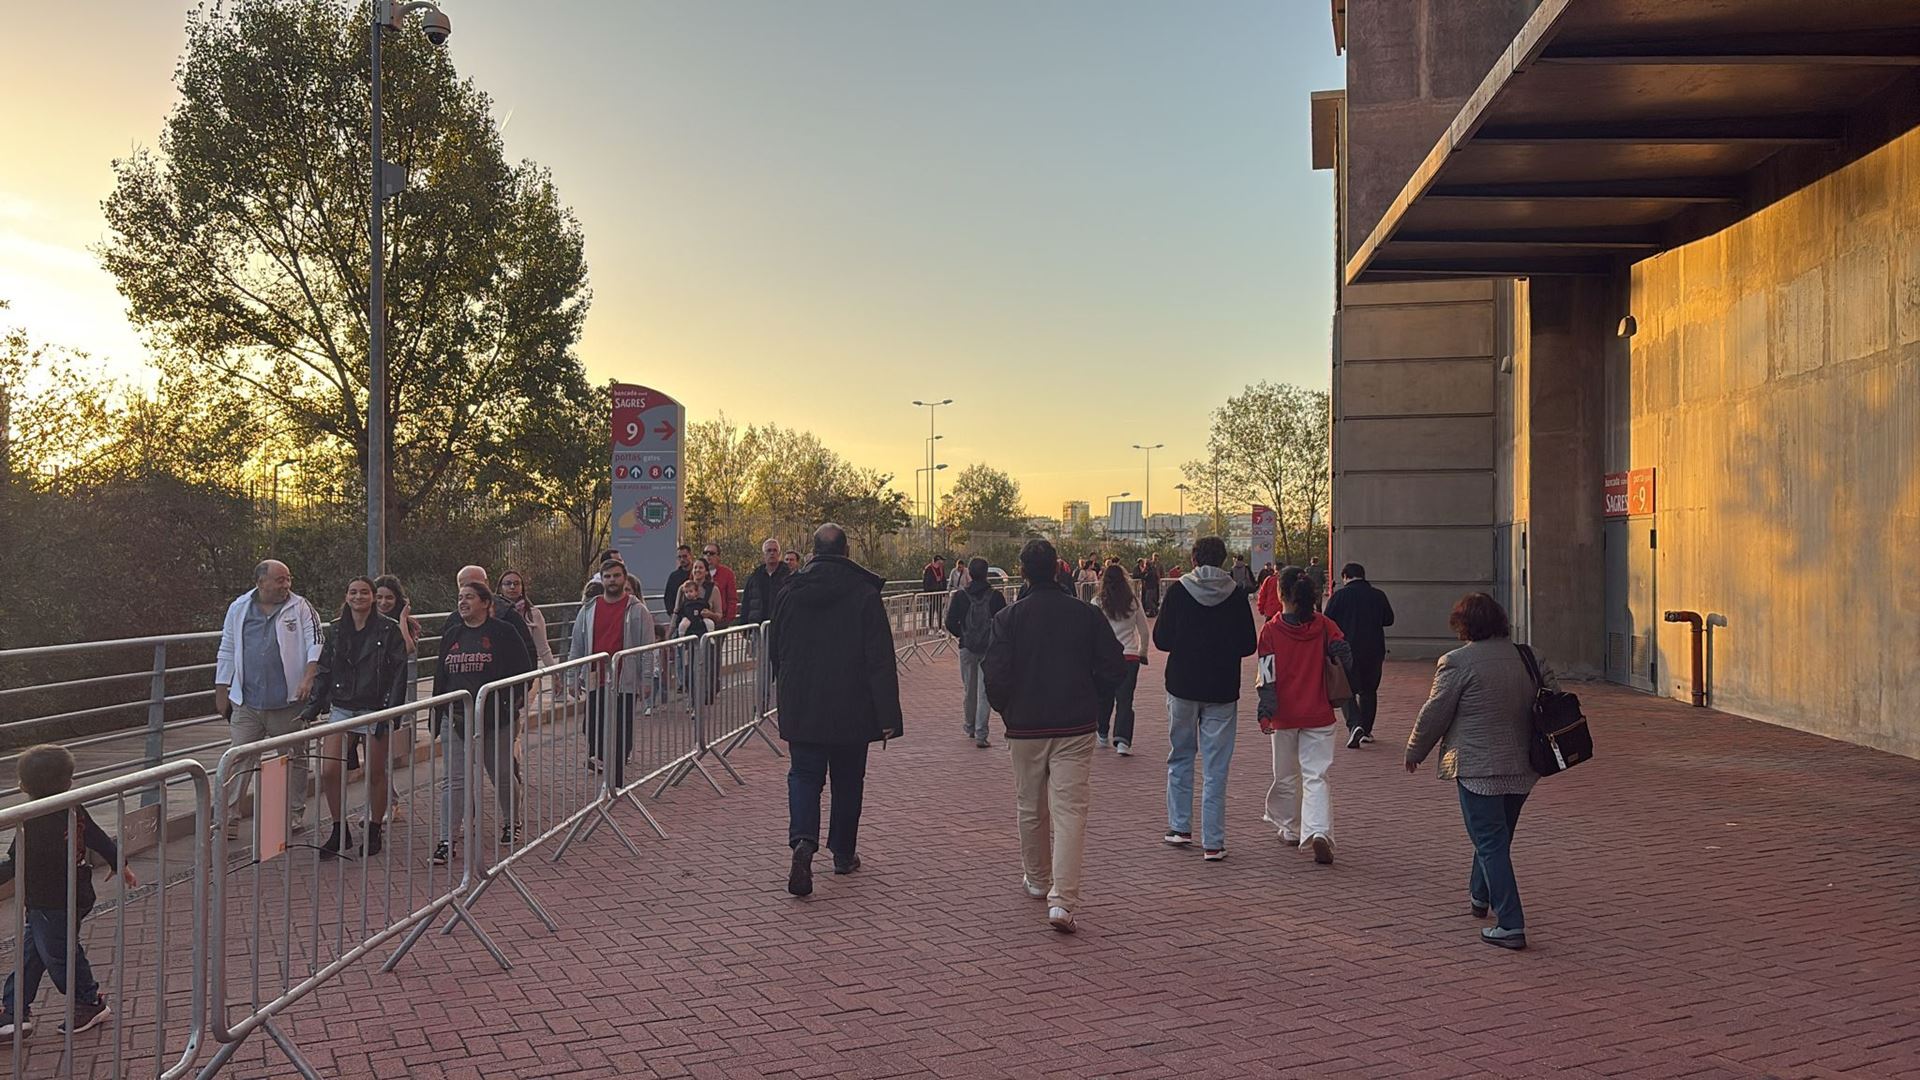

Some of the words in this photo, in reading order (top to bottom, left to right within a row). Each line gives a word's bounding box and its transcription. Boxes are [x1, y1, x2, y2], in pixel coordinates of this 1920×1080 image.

[615, 398, 646, 409] SAGRES
[626, 422, 639, 441] 9
[619, 467, 625, 477] 7
[652, 467, 659, 477] 8
[1640, 486, 1646, 513] 9
[445, 652, 493, 665] Emirates
[449, 663, 459, 673] FLY
[461, 662, 485, 673] BETTER
